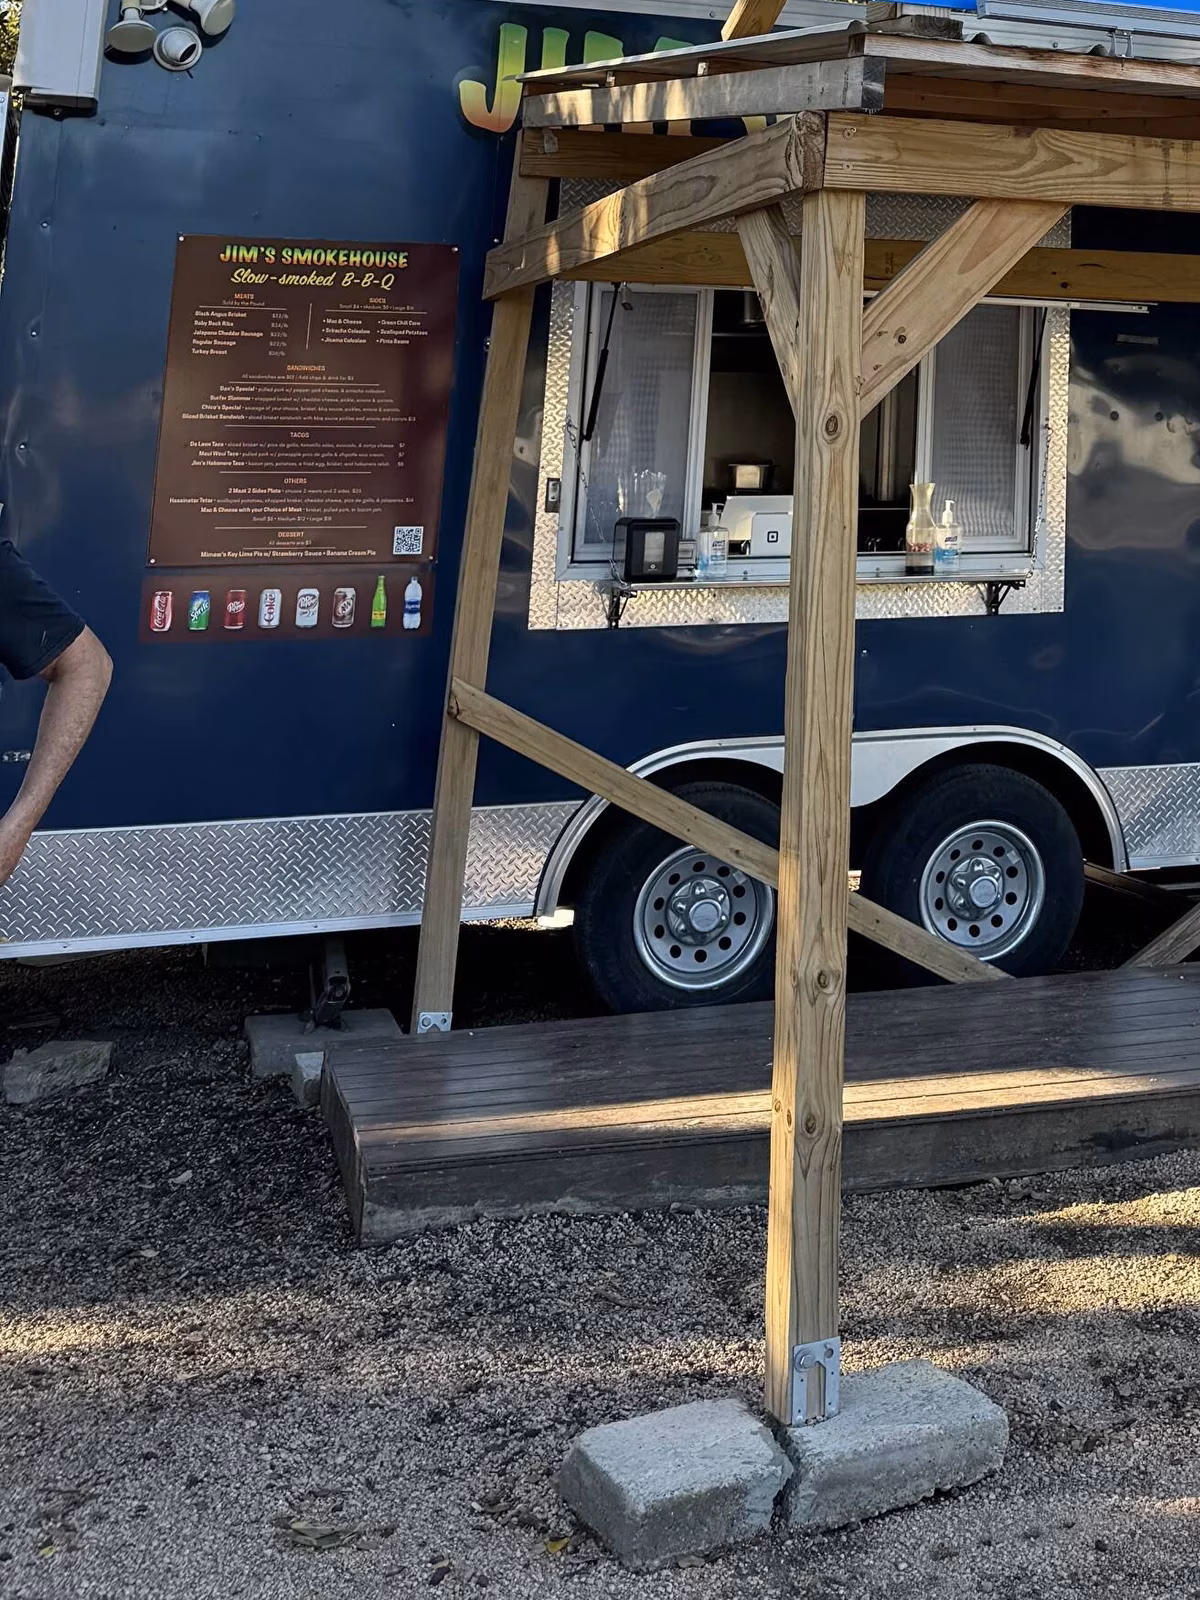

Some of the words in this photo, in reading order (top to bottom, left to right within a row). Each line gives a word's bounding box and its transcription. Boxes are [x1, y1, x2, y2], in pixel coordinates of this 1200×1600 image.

[219, 244, 276, 264] JIM'S
[281, 247, 409, 269] SMOKEHOUSE
[342, 272, 395, 291] B-B-Q
[286, 364, 326, 372] SANDWICHES
[290, 431, 310, 439] TACOS
[227, 551, 238, 559] Key
[272, 550, 304, 559] Strawberry
[190, 600, 209, 621] Sprite
[264, 594, 276, 624] Coke
